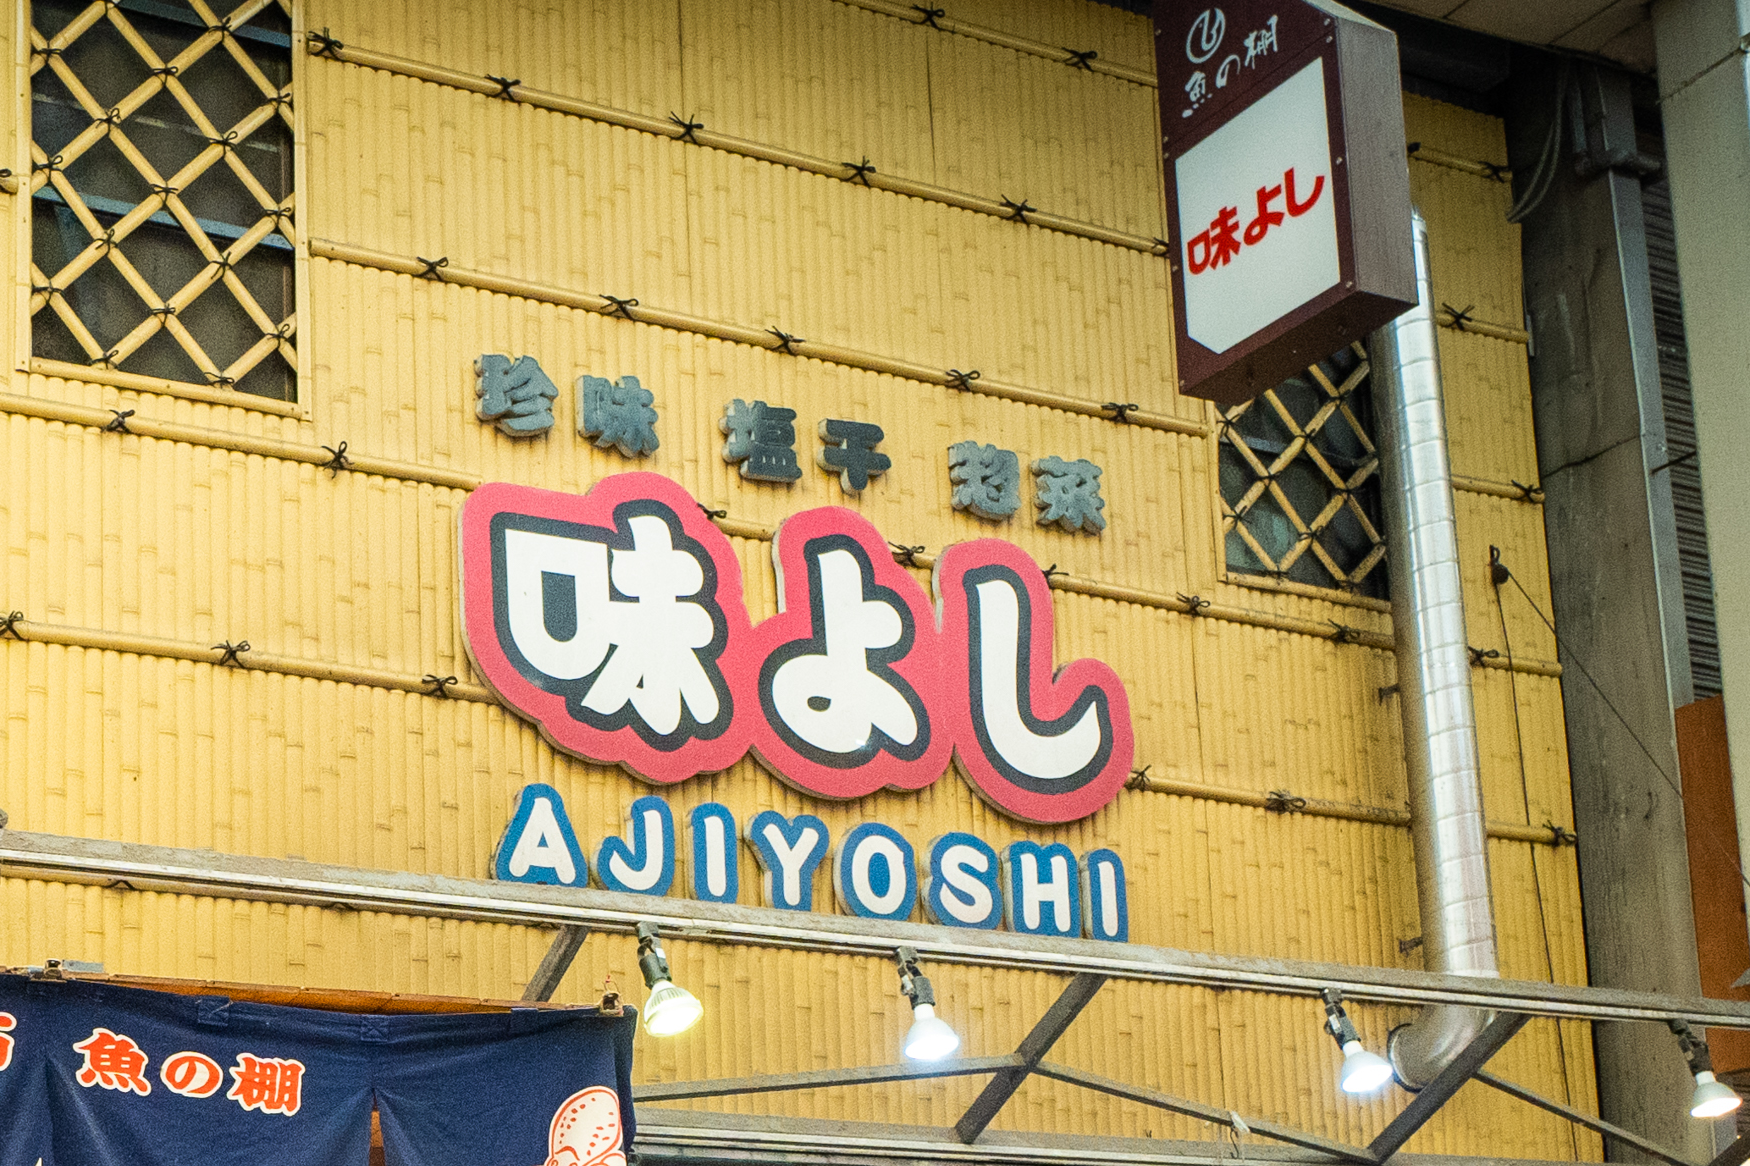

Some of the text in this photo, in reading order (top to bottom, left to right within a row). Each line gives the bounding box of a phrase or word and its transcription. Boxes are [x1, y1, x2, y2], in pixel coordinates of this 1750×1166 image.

[1186, 167, 1326, 276] 味よし
[473, 352, 1108, 536] 珍味 塩干 惣菜
[490, 495, 1115, 795] 味よし
[498, 788, 1123, 940] AJIYOSHI
[72, 1026, 305, 1117] 魚の棚
